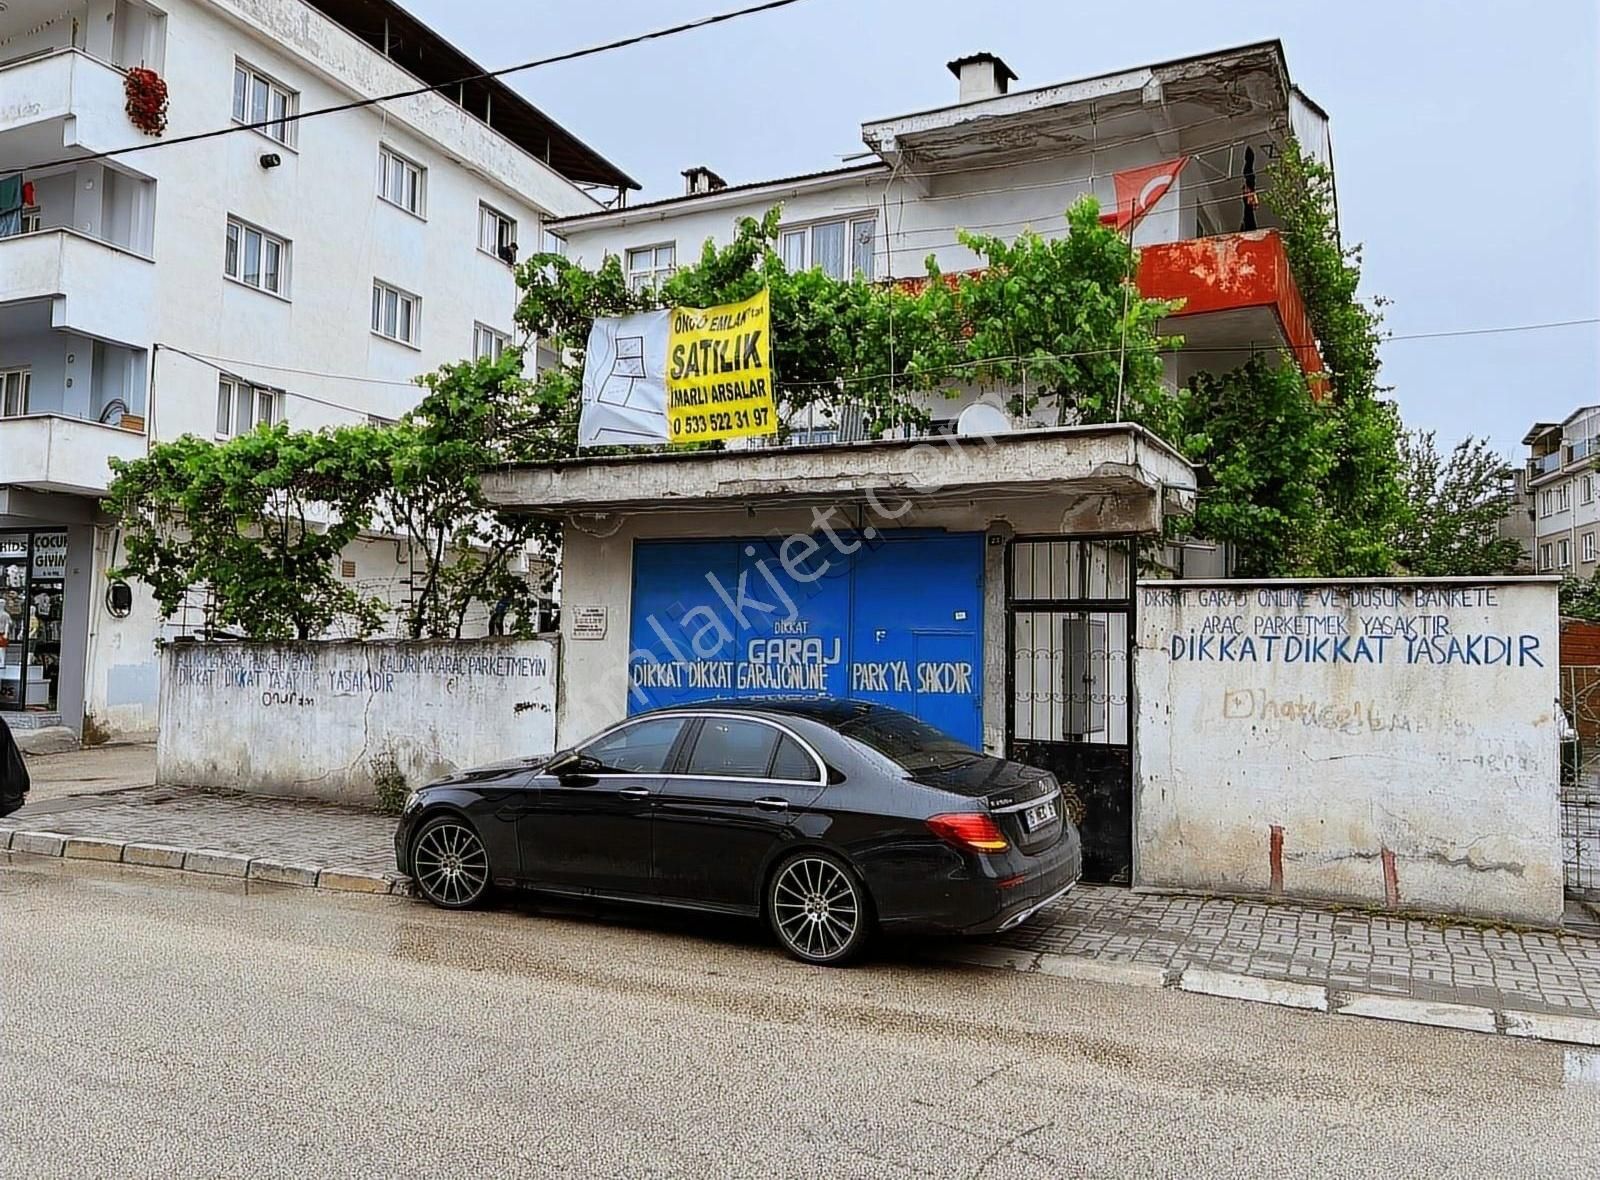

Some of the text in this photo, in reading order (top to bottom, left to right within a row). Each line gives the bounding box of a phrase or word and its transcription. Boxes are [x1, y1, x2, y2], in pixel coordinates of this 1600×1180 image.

[670, 331, 762, 380] SATILIK
[711, 378, 766, 403] ARSALAR
[673, 407, 768, 435] 0 533 522 31 97
[1199, 589, 1248, 607] GARAJ
[1202, 616, 1244, 635] ARAÇ
[1255, 615, 1348, 635] PARKETMEK
[748, 637, 841, 665] GARAJ
[1403, 634, 1544, 667] YASAKDIR
[634, 659, 682, 688] DİKKAT
[688, 658, 734, 689] DİKKAT
